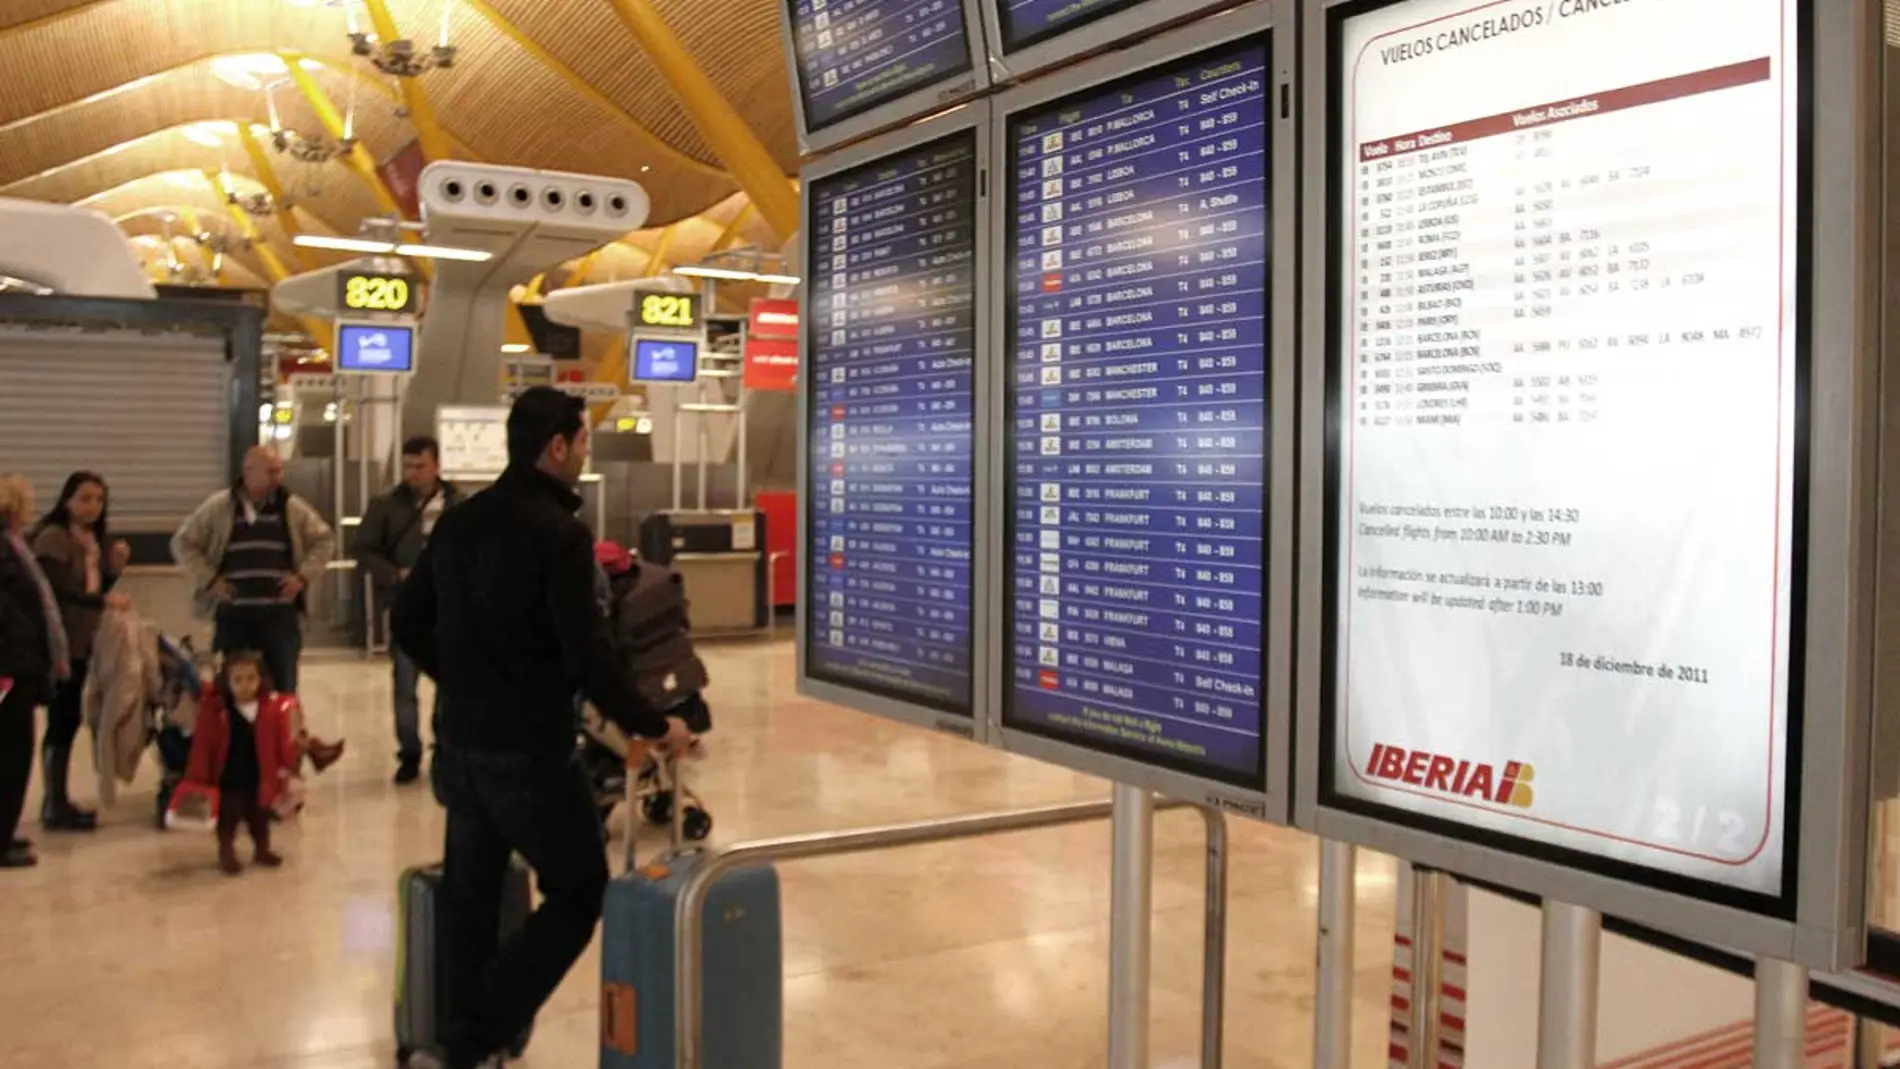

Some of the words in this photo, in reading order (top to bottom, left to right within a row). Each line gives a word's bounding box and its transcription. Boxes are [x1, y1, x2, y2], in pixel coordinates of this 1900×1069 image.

[1380, 37, 1434, 65] VUELOS
[1436, 6, 1543, 51] CANCELADOS
[1105, 211, 1154, 228] BARCELONA
[1105, 236, 1154, 253] BARCELONA
[1105, 262, 1153, 277] BARCELONA
[345, 275, 409, 311] 820
[1105, 287, 1153, 302] BARCELONA
[641, 294, 694, 327] 821
[1105, 313, 1153, 326] BARCELONA
[1105, 338, 1153, 351] BARCELONA
[1104, 363, 1158, 375] MANCHESTER
[1104, 388, 1158, 400] MANCHESTER
[1104, 438, 1153, 450] AMSTERDAM
[1104, 463, 1153, 475] AMSTERDAM
[1103, 488, 1150, 500] FRANKFURT
[1103, 513, 1150, 525] FRANKFURT
[1359, 503, 1388, 515] Vuelos
[1390, 504, 1441, 517] cancelados
[1444, 507, 1469, 518] entre
[1472, 505, 1486, 519] las
[1490, 506, 1518, 520] 10:00
[1530, 507, 1544, 521] las
[1548, 508, 1580, 523] 14:30
[1403, 524, 1429, 541] flights
[1433, 525, 1457, 542] from
[1460, 527, 1489, 542] 10:00
[1490, 529, 1510, 543] AM
[1512, 531, 1522, 544] to
[1525, 530, 1549, 545] 2:30
[1551, 531, 1571, 546] PM
[1103, 538, 1150, 550] FRANKFURT
[1103, 562, 1149, 575] FRANKFURT
[1358, 564, 1368, 578] La
[1426, 572, 1437, 582] se
[1504, 578, 1531, 592] partir
[1534, 577, 1550, 592] de
[1552, 580, 1566, 594] las
[1571, 580, 1603, 596] 13:00
[1103, 587, 1149, 600] FRANKFURT
[1358, 585, 1408, 602] Information
[1412, 590, 1428, 602] will
[1430, 591, 1441, 605] be
[1445, 595, 1484, 610] updated
[1488, 597, 1514, 613] after
[1517, 599, 1540, 615] 1:00
[1542, 601, 1563, 616] PM
[1103, 612, 1149, 625] FRANKFURT
[1560, 651, 1574, 666] 18
[1576, 653, 1591, 669] de
[1593, 655, 1654, 677] diciembre
[1657, 663, 1674, 680] de
[1678, 664, 1709, 684] 2011
[1364, 742, 1494, 801] IBERIA
